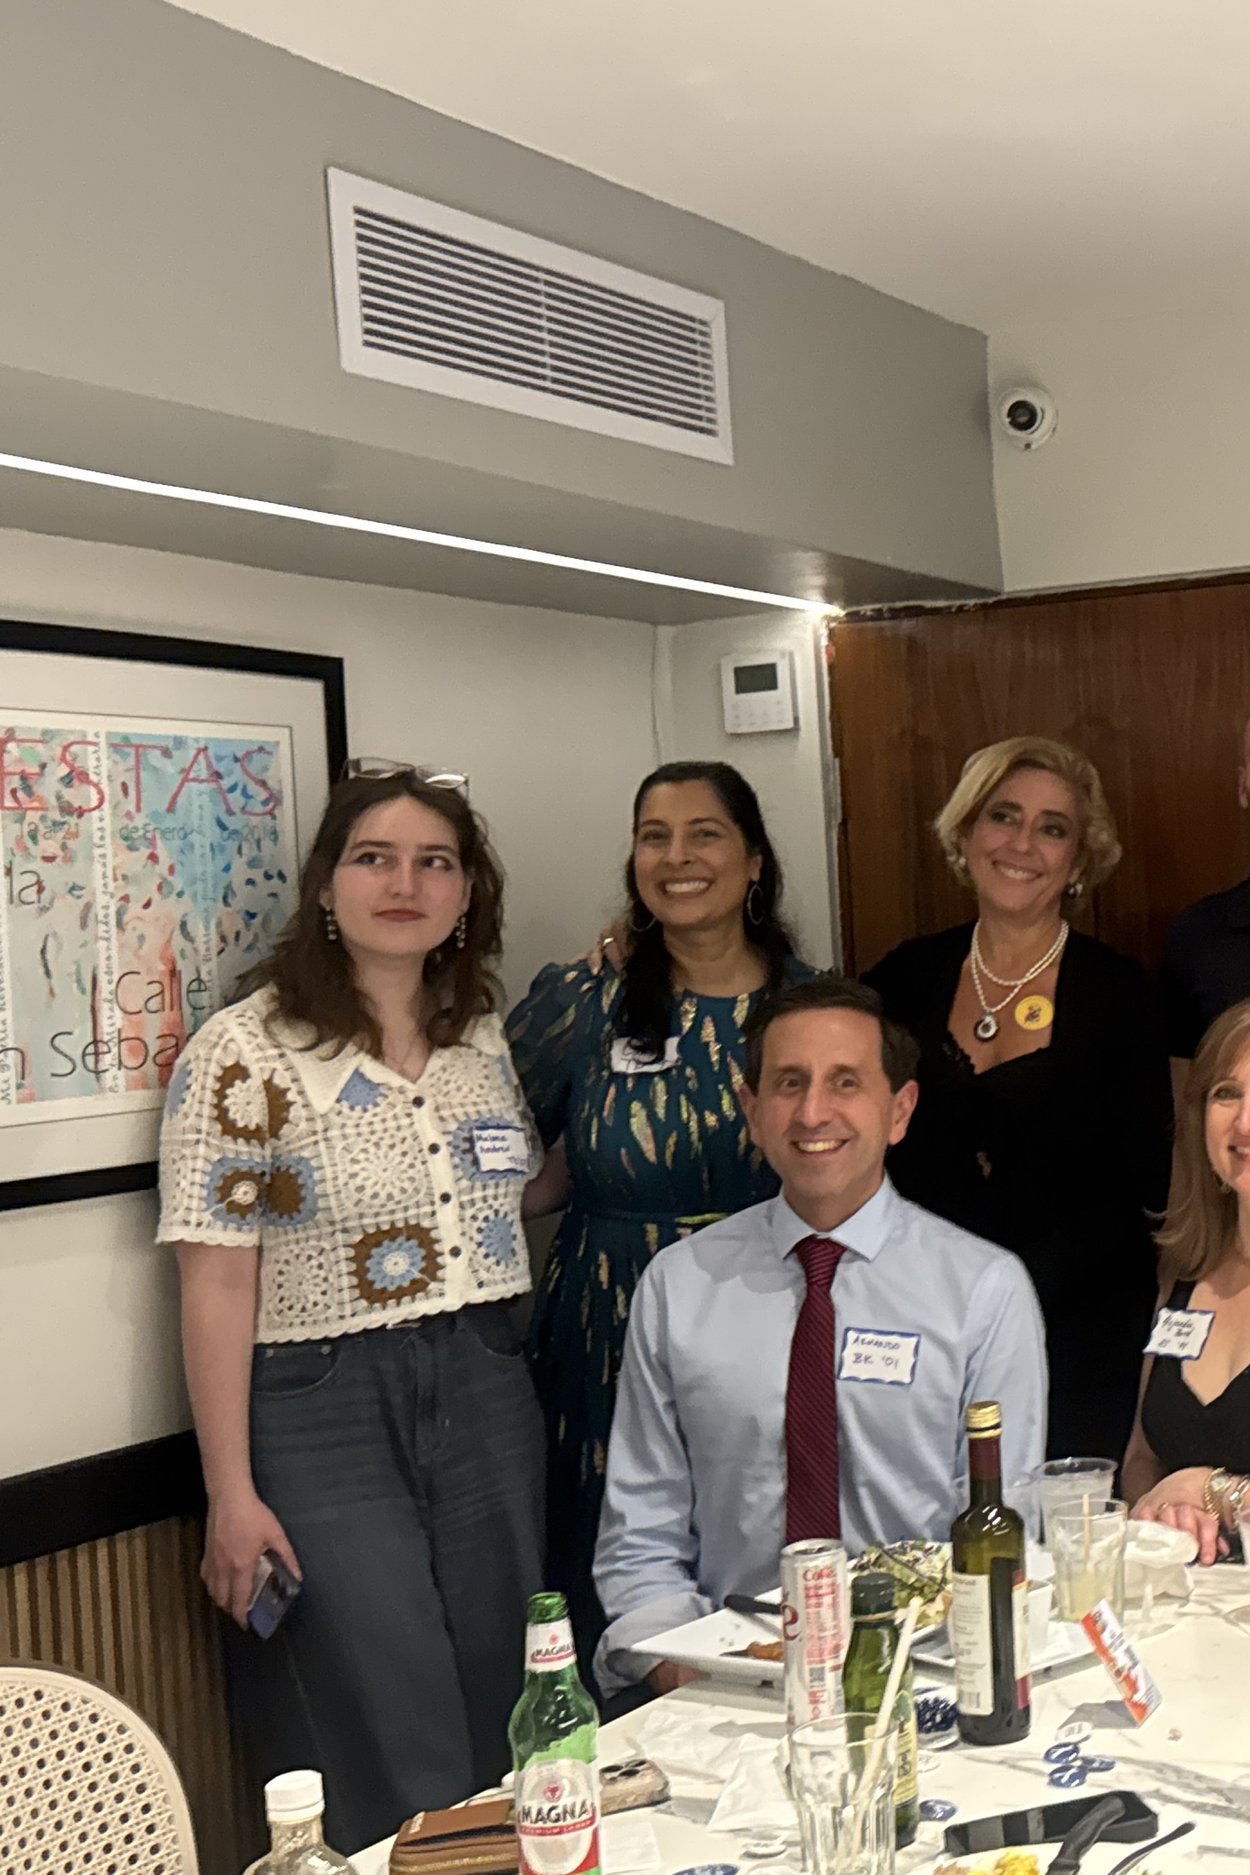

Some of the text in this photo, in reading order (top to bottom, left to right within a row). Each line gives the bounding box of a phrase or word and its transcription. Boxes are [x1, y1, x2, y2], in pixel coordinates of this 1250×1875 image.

[9, 860, 42, 905] la
[115, 967, 208, 1016] Calle
[50, 1028, 196, 1078] Seba
[521, 1798, 591, 1826] MAGNA
